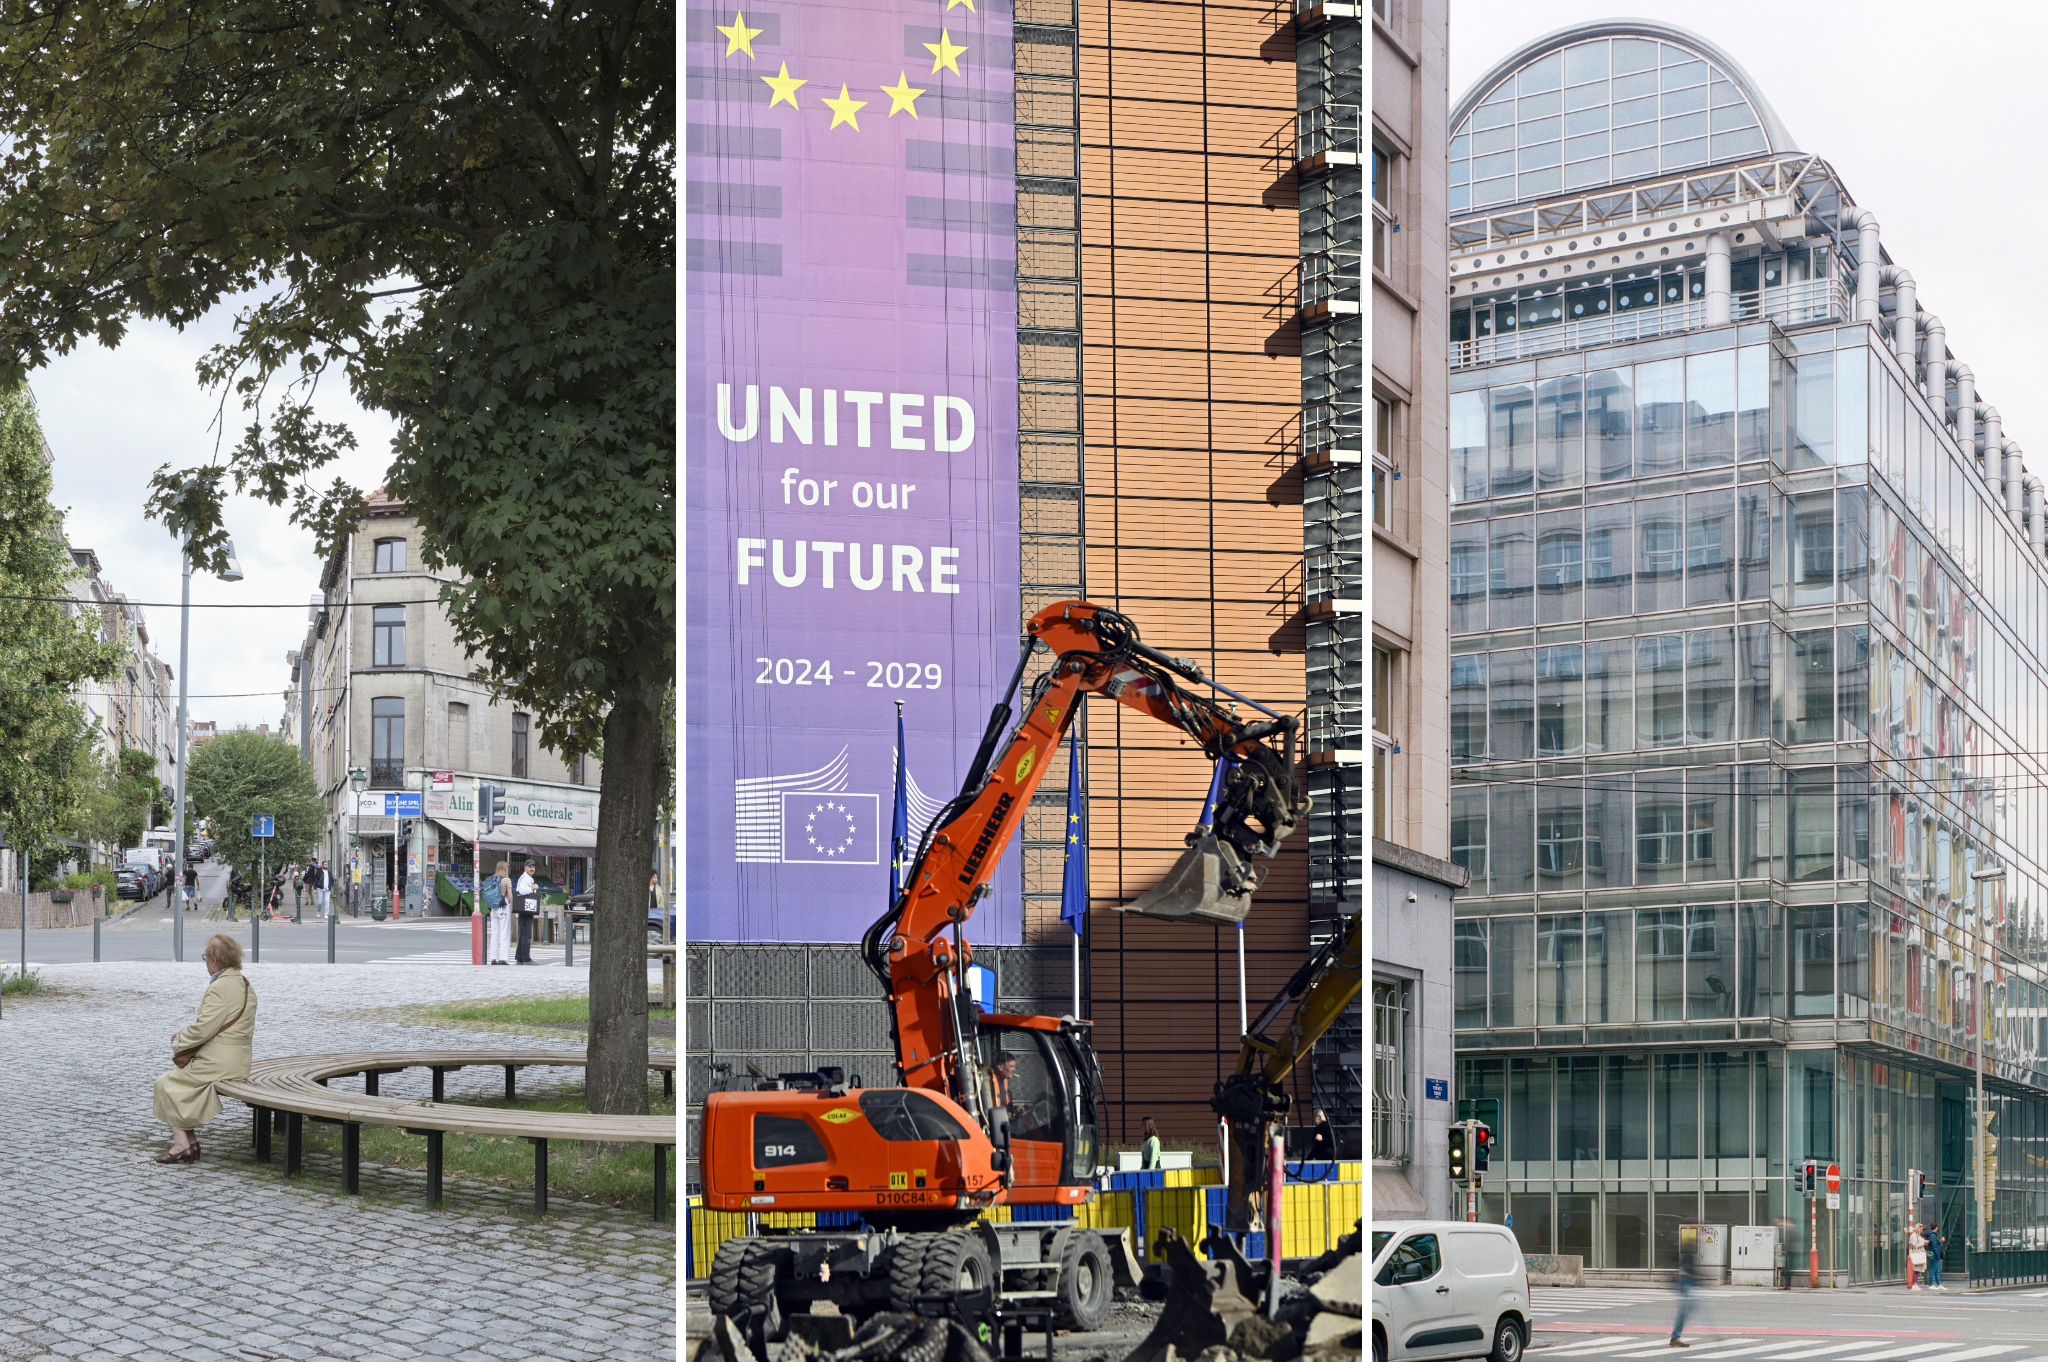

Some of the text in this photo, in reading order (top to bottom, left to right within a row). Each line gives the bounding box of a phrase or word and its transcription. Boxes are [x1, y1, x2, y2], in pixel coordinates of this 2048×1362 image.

[717, 383, 975, 452] UNITED
[781, 468, 916, 509] for our
[738, 538, 960, 594] FUTURE
[756, 657, 833, 686] 2024
[866, 661, 942, 689] 2029
[1017, 758, 1030, 778] COLAS
[448, 794, 573, 820] Alimion Générale
[958, 791, 1015, 885] LIEBHERR
[827, 1111, 847, 1119] COLAS
[764, 1144, 796, 1157] 914
[956, 1174, 984, 1187] A157
[876, 1192, 926, 1204] D10C84
